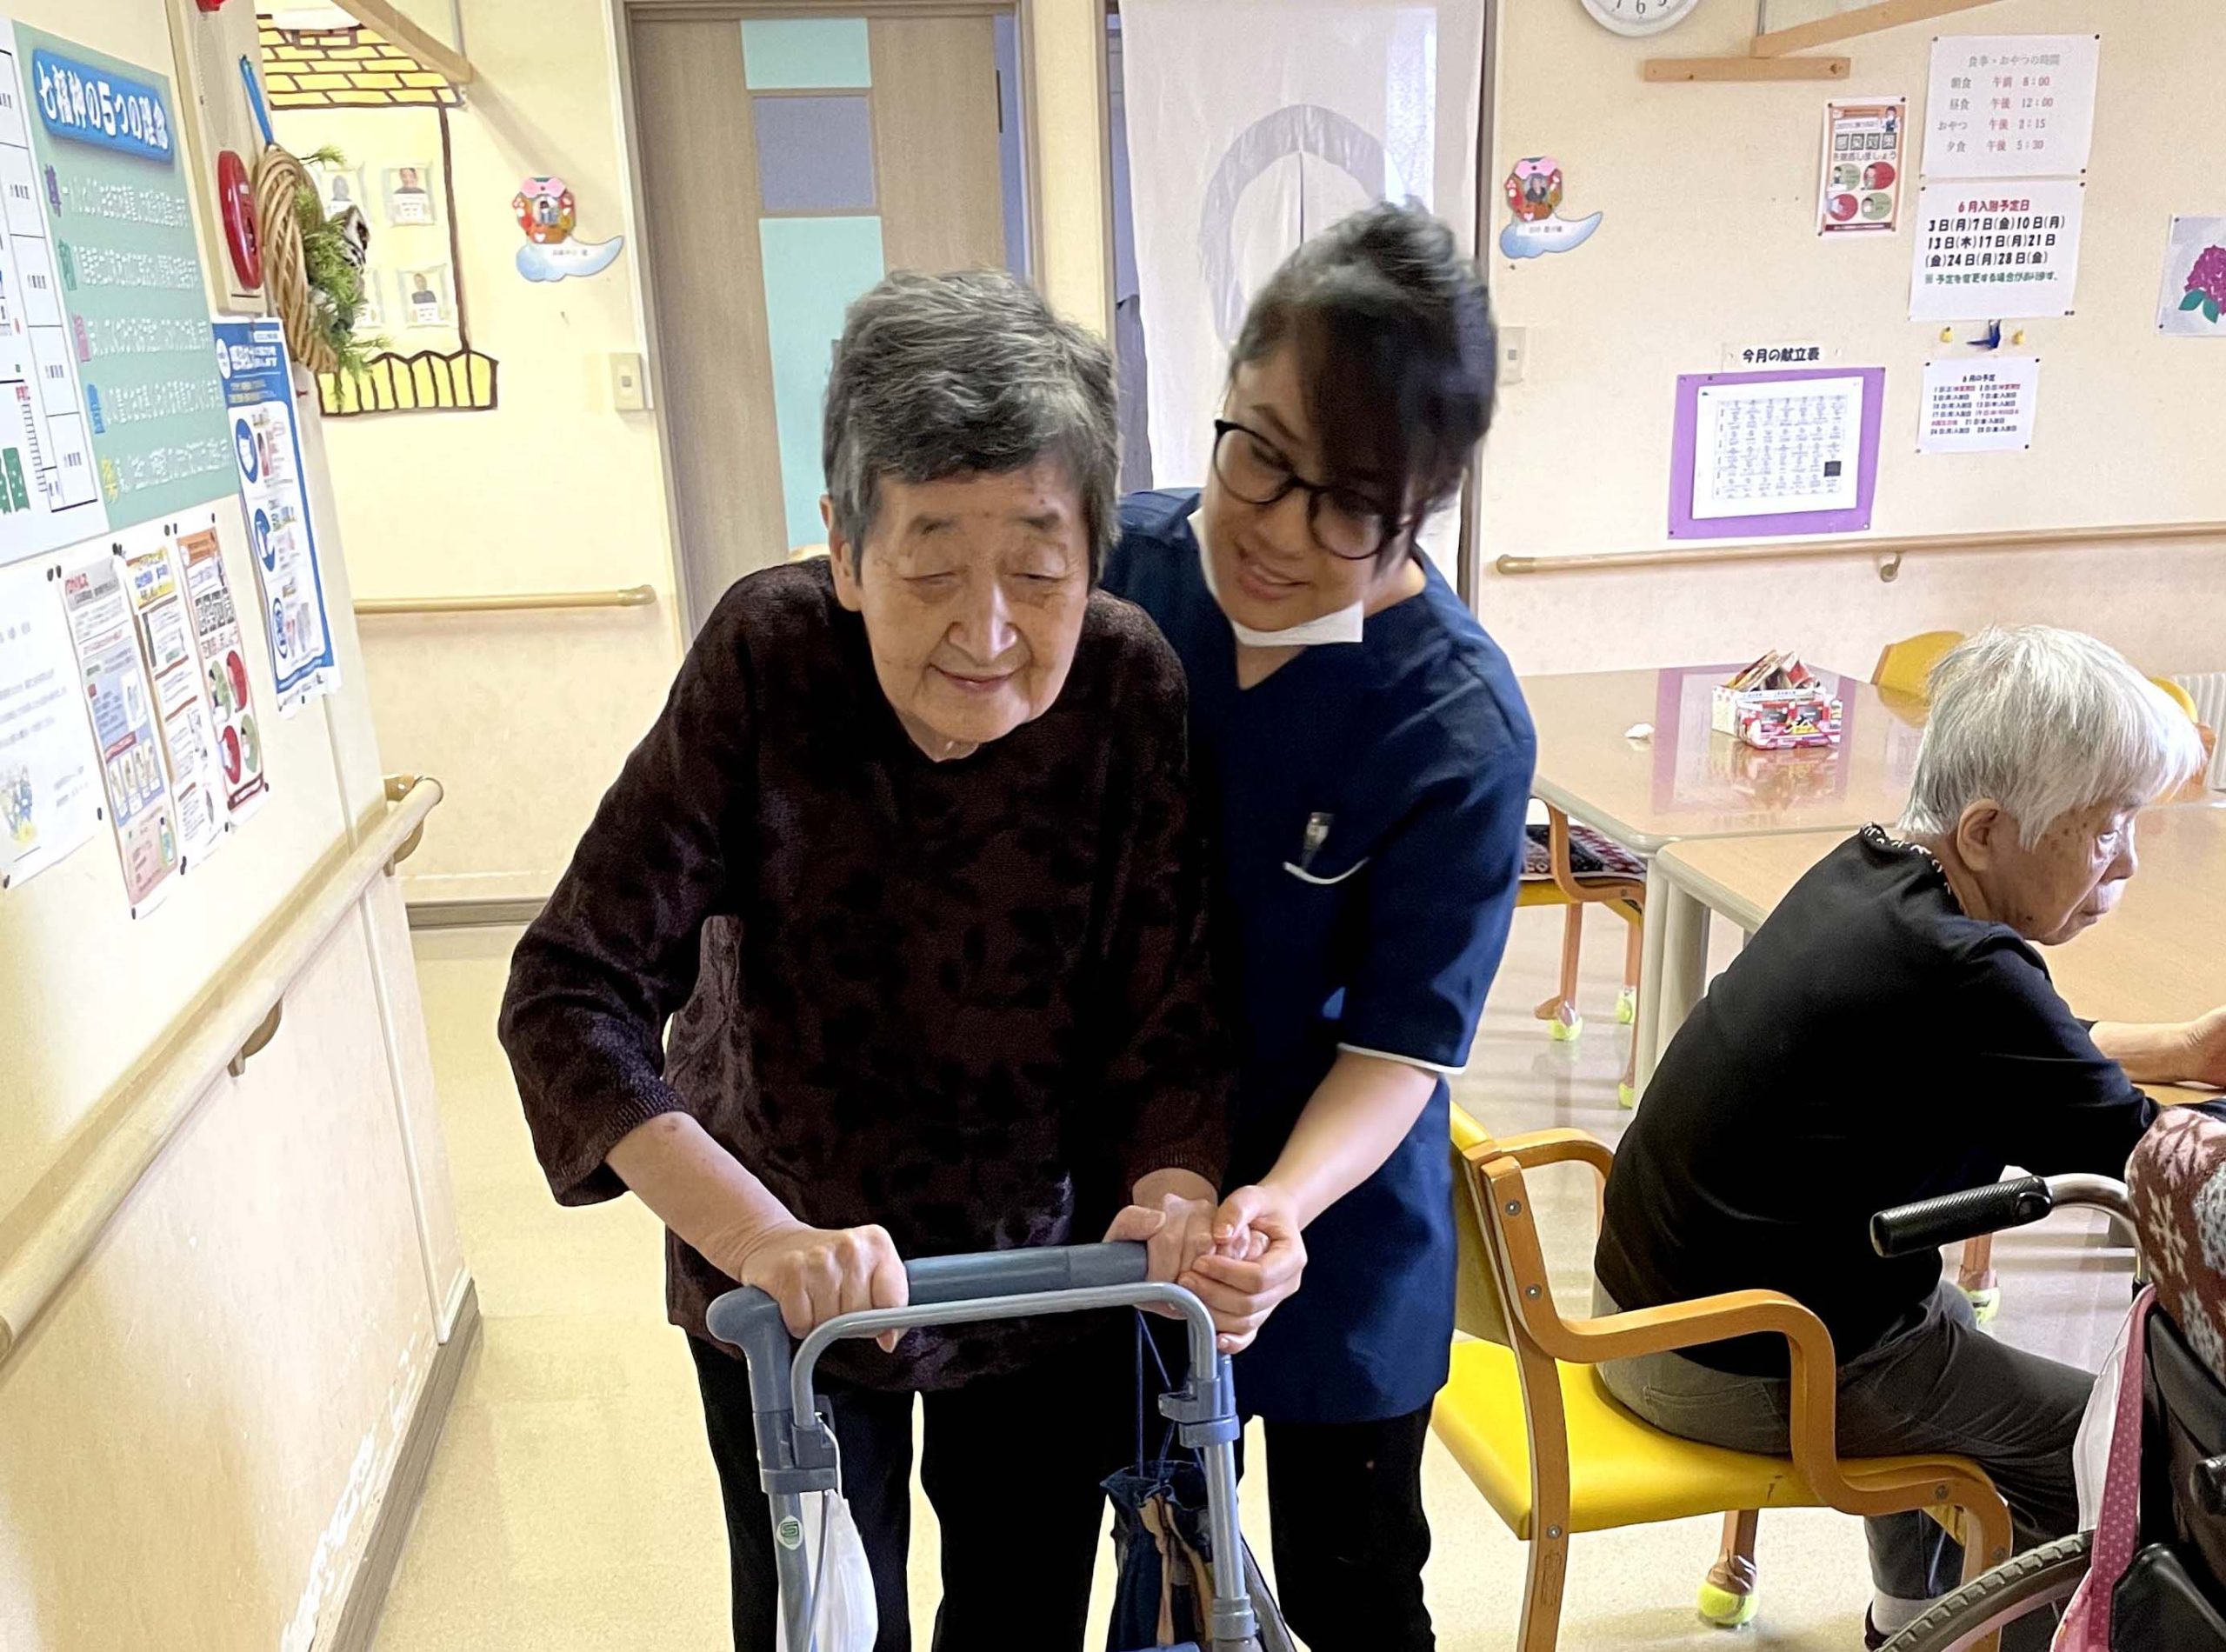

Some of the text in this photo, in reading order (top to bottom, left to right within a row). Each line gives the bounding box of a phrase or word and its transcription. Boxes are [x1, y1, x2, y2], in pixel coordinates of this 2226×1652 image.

[1969, 54, 2061, 68] 食事・おやつの時間
[37, 60, 169, 150] 七福神の5つの理念
[1937, 120, 1968, 131] おやつ
[1743, 347, 1820, 363] 今月の献立表
